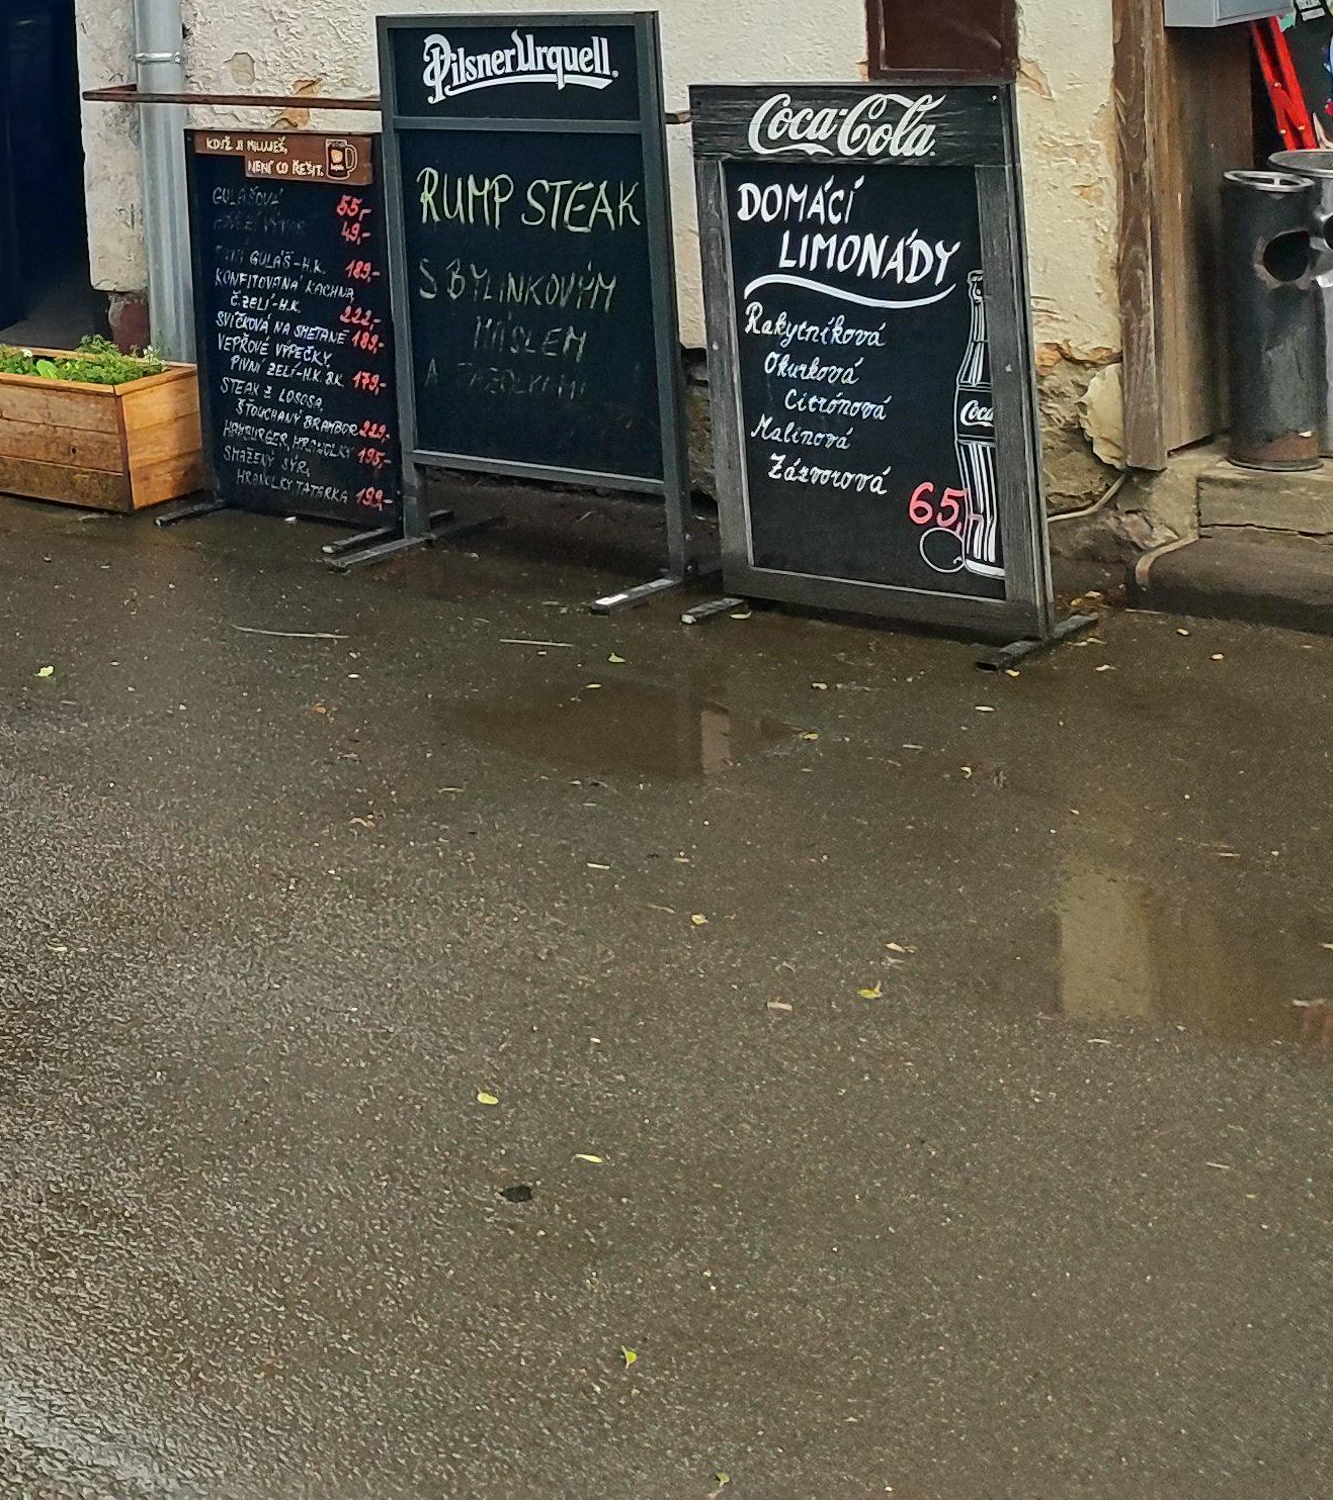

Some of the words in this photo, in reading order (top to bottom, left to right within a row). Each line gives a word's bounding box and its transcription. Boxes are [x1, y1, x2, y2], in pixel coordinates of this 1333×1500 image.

[423, 34, 516, 104] Pilsner
[511, 29, 614, 90] Urquell
[748, 93, 947, 157] Coca-Cola
[416, 167, 515, 230] RUMP
[521, 179, 641, 233] STEAK
[736, 174, 865, 223] DOMÁCÍ
[778, 228, 961, 287] LIMONÁDY
[745, 302, 886, 348] Rakytníková
[764, 351, 864, 385] Okurková
[784, 389, 892, 420] Citrónová
[750, 413, 854, 450] Malinová
[768, 453, 891, 495] Zázvorová
